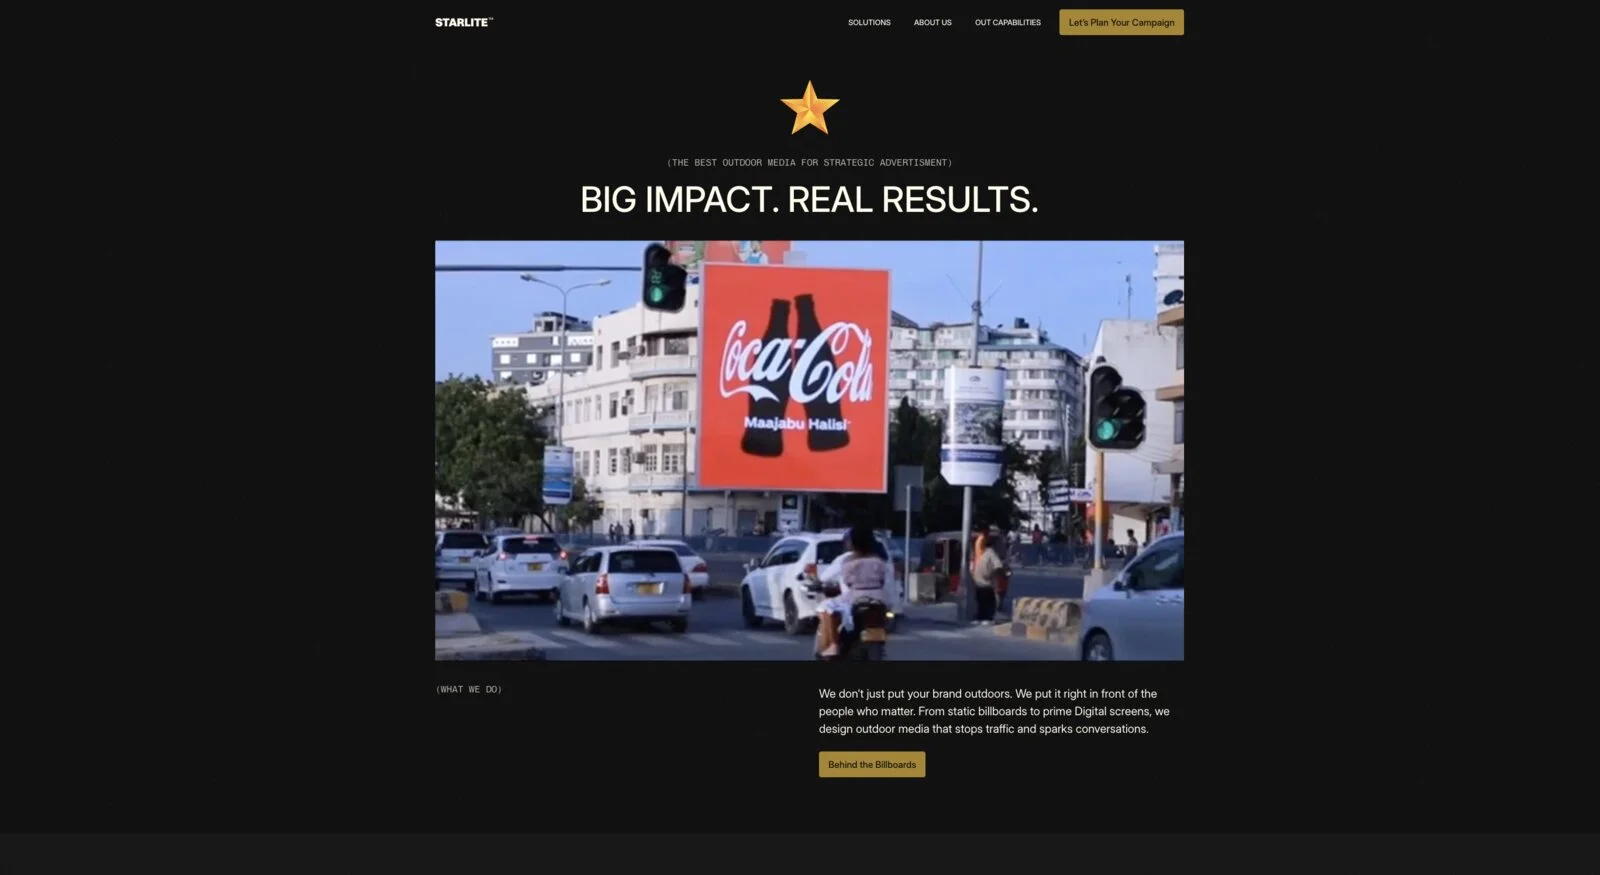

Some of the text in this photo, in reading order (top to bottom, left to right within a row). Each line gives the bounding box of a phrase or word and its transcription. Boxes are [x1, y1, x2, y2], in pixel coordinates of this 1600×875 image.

[848, 18, 891, 27] SOLUTIONS
[913, 18, 952, 27] ABOUT US
[974, 18, 1041, 27] OUT CAPABILITIES
[1068, 18, 1174, 29] Let's Plan Your Campaign
[667, 158, 951, 168] (THE BEST OUTDOOR MEDIA FOR STRATEGIC ADVERTISMENT)
[582, 186, 1037, 212] BIG IMPACT. REAL RESULTS.
[719, 320, 873, 404] Coca-Cola
[744, 416, 805, 431] Maajabu
[436, 684, 501, 695] (WHAT WE DO)
[818, 688, 1157, 701] We don't just put your brand outdoors. We put it right in front of the
[818, 705, 1169, 719] people who matter. From static billboards to prime Digital screens, we
[818, 723, 1148, 736] design outdoor media that stops traffic and sparks conversations.
[828, 760, 916, 769] Behind the Billboards
